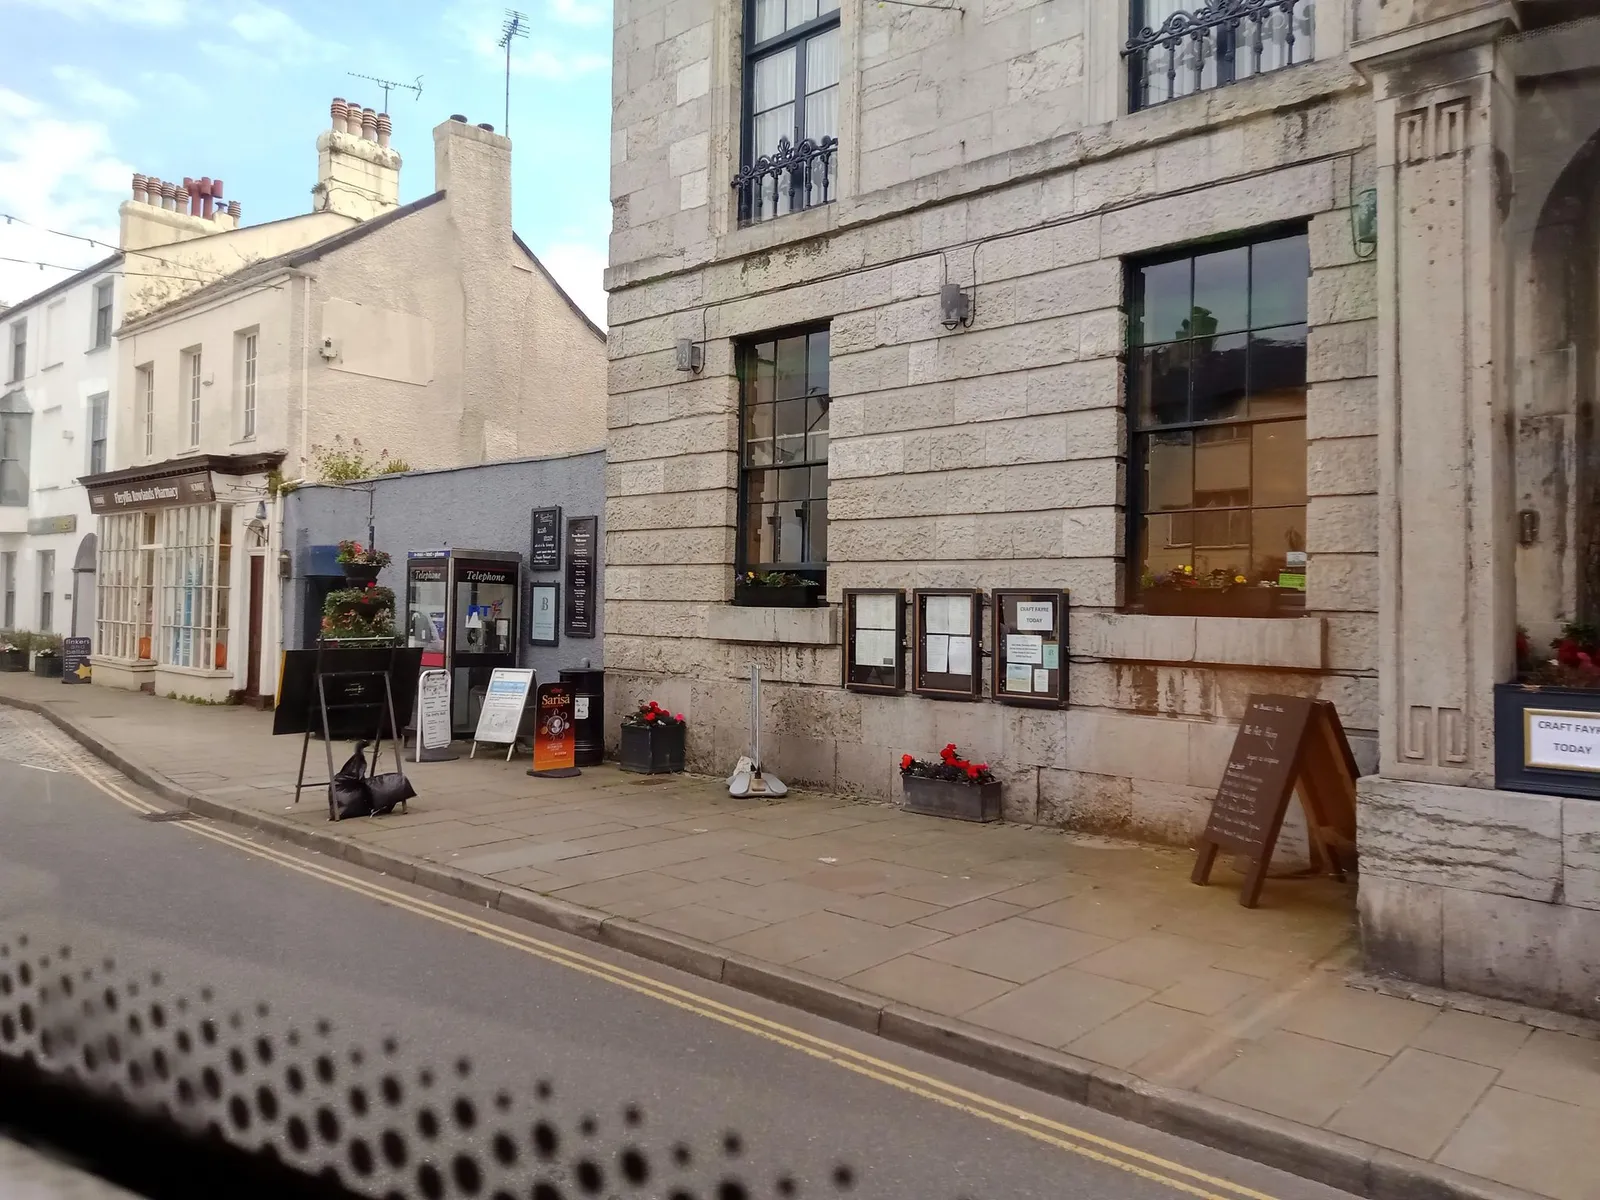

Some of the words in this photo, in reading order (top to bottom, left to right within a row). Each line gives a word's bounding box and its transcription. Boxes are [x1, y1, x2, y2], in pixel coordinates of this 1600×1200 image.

[154, 486, 179, 500] Pharmacy
[414, 570, 442, 581] Telephone
[466, 570, 506, 583] Telephone
[1538, 720, 1572, 732] CRAFT
[1553, 742, 1592, 754] TODAY
